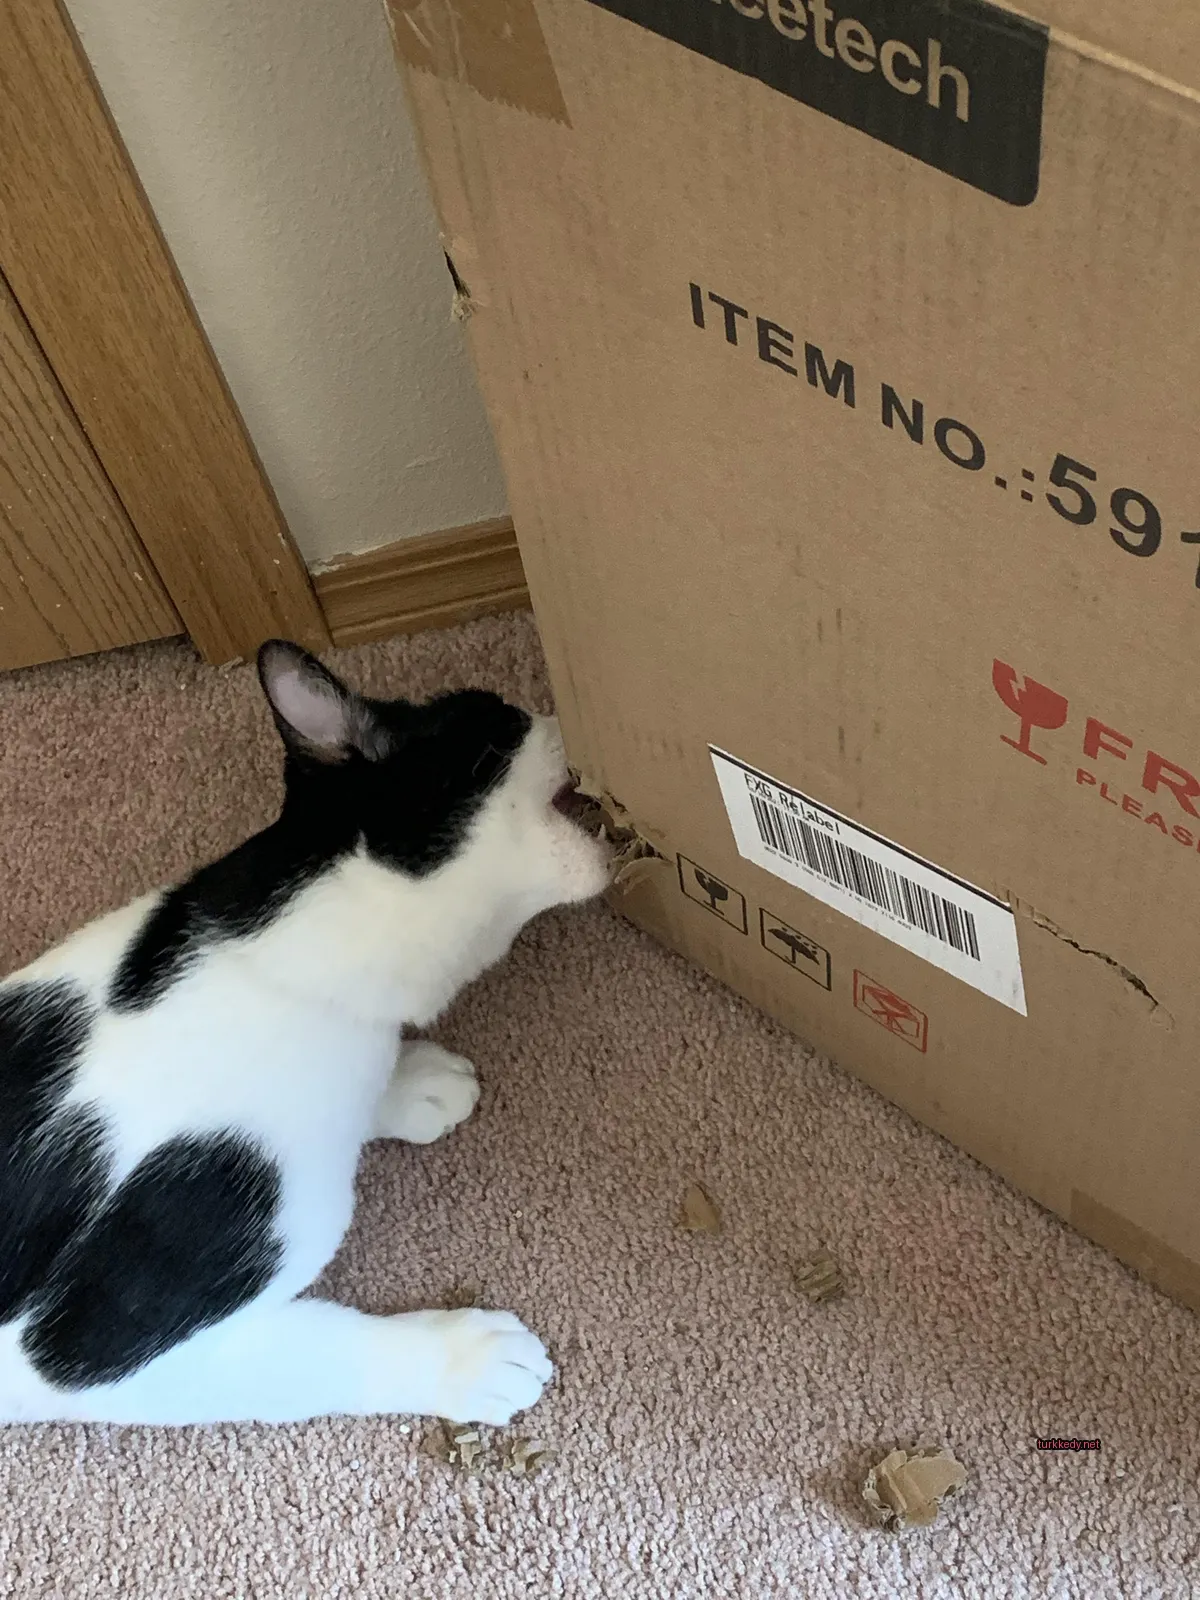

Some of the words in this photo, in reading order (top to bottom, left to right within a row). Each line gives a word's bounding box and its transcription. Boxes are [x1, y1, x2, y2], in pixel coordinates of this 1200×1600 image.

[691, 0, 970, 123] etech
[688, 282, 856, 409] ITEM
[744, 772, 773, 799] FXG
[1076, 767, 1200, 854] PLEAS
